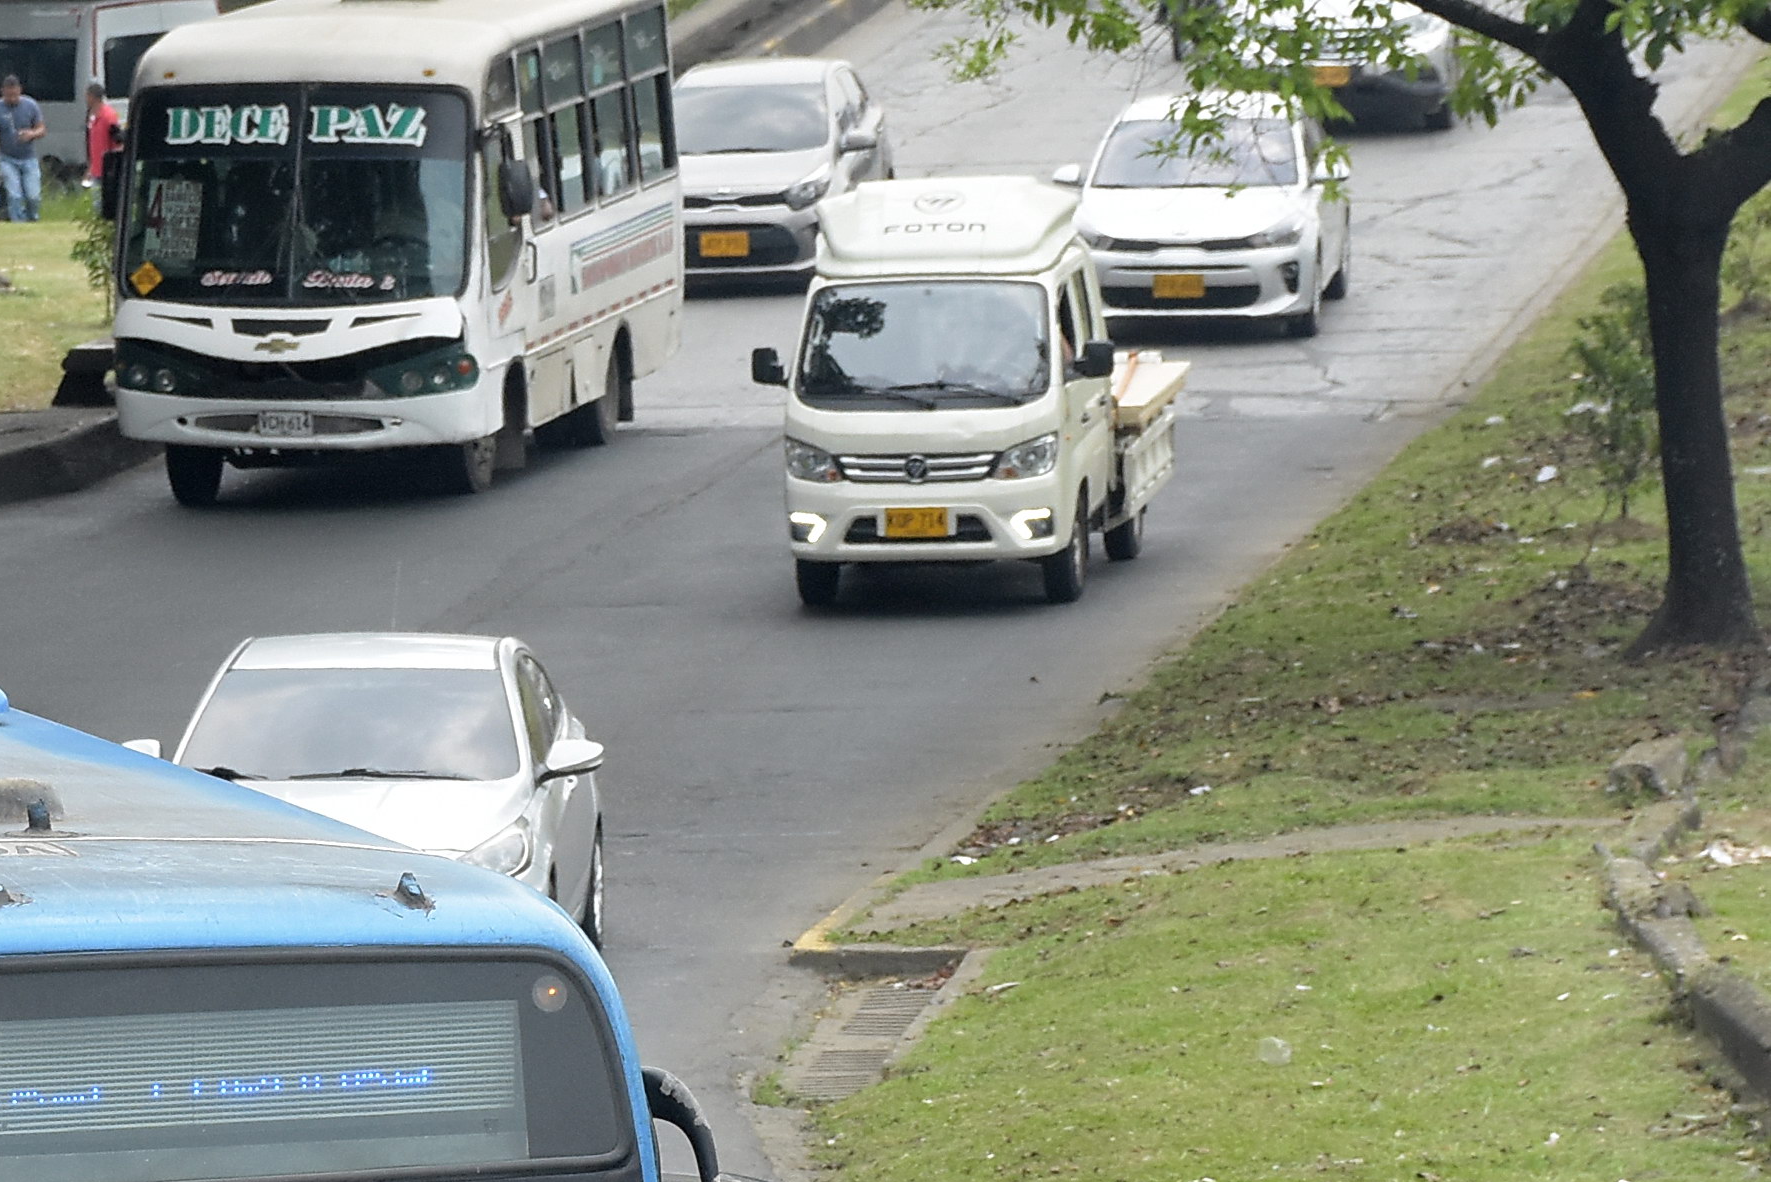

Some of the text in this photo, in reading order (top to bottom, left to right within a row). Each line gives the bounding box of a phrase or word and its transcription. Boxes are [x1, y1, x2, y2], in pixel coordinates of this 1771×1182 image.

[166, 102, 427, 147] DECE PAZ
[884, 223, 986, 235] FOTON
